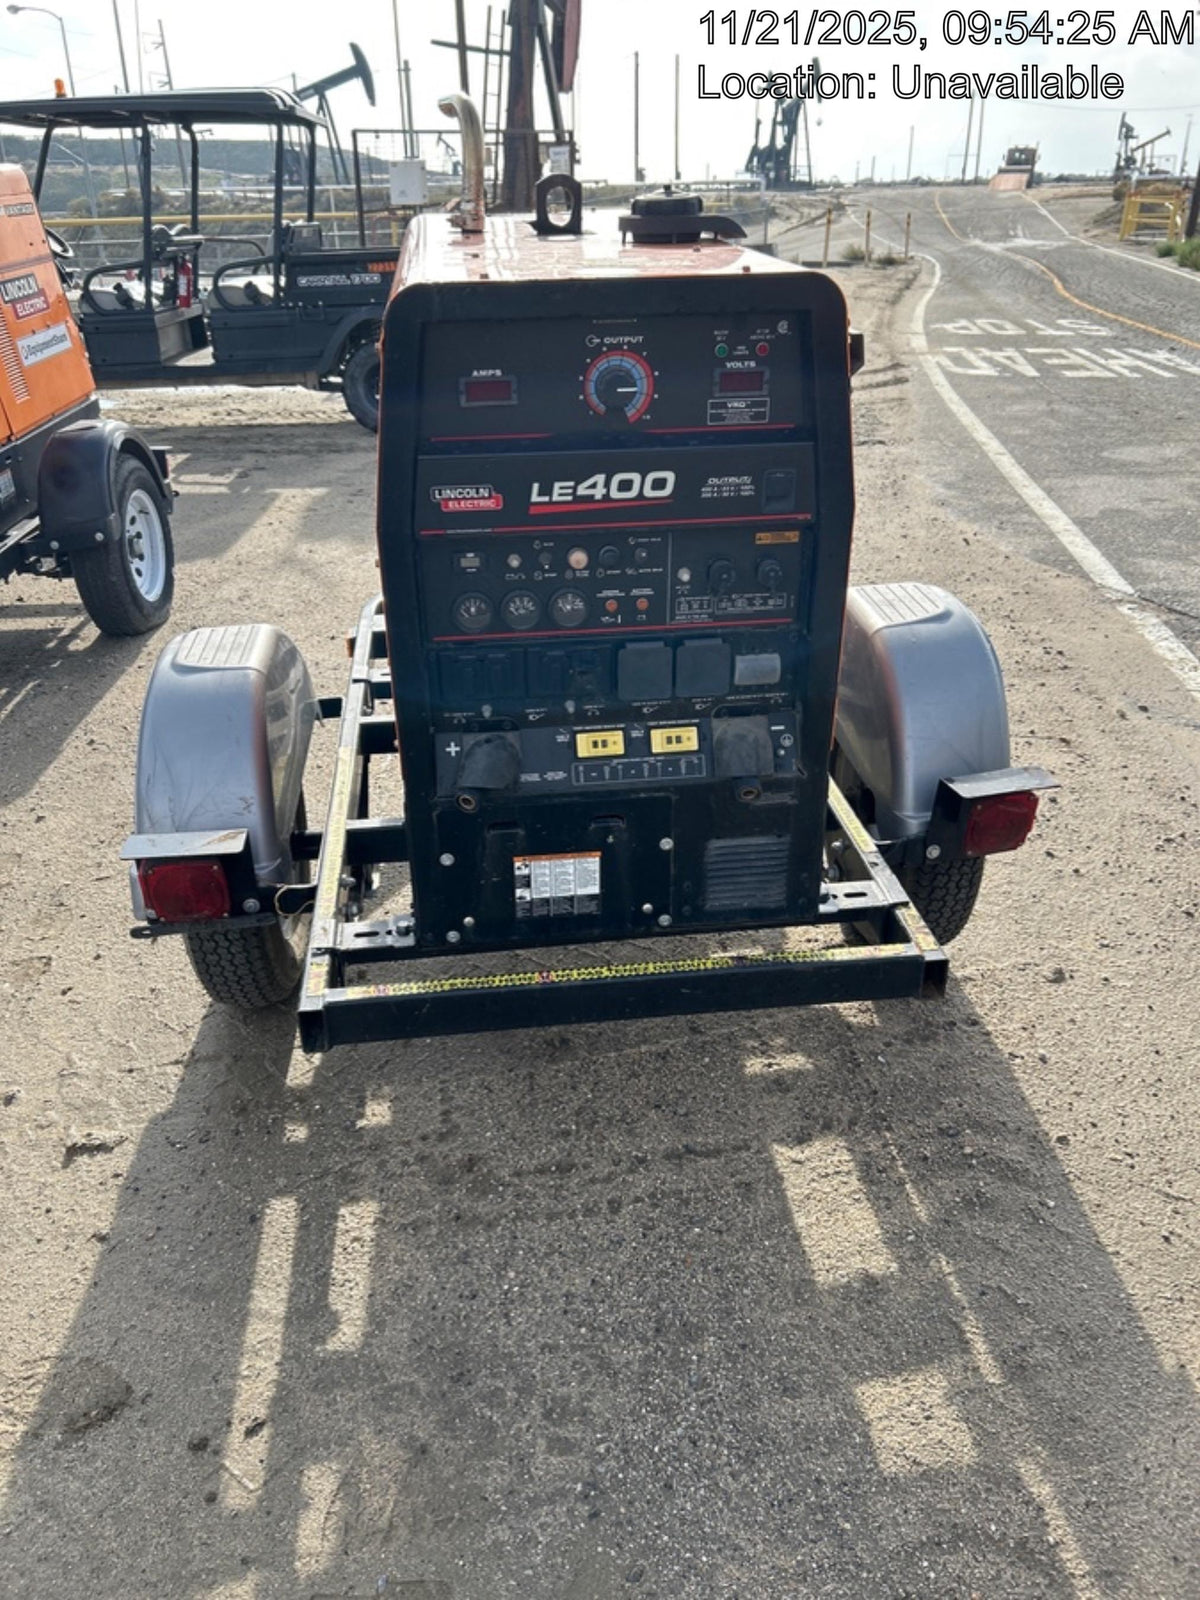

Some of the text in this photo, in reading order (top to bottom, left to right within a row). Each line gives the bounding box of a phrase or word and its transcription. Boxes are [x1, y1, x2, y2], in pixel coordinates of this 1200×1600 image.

[1, 277, 37, 301] LINCOLN
[16, 296, 48, 317] ELECTRIC
[603, 335, 644, 344] OUTPUT
[725, 360, 757, 369] VOLTS
[472, 368, 502, 378] AMPS
[530, 470, 676, 503] LE400
[434, 487, 491, 500] LINCOLN
[448, 499, 498, 510] ELECTRIC
